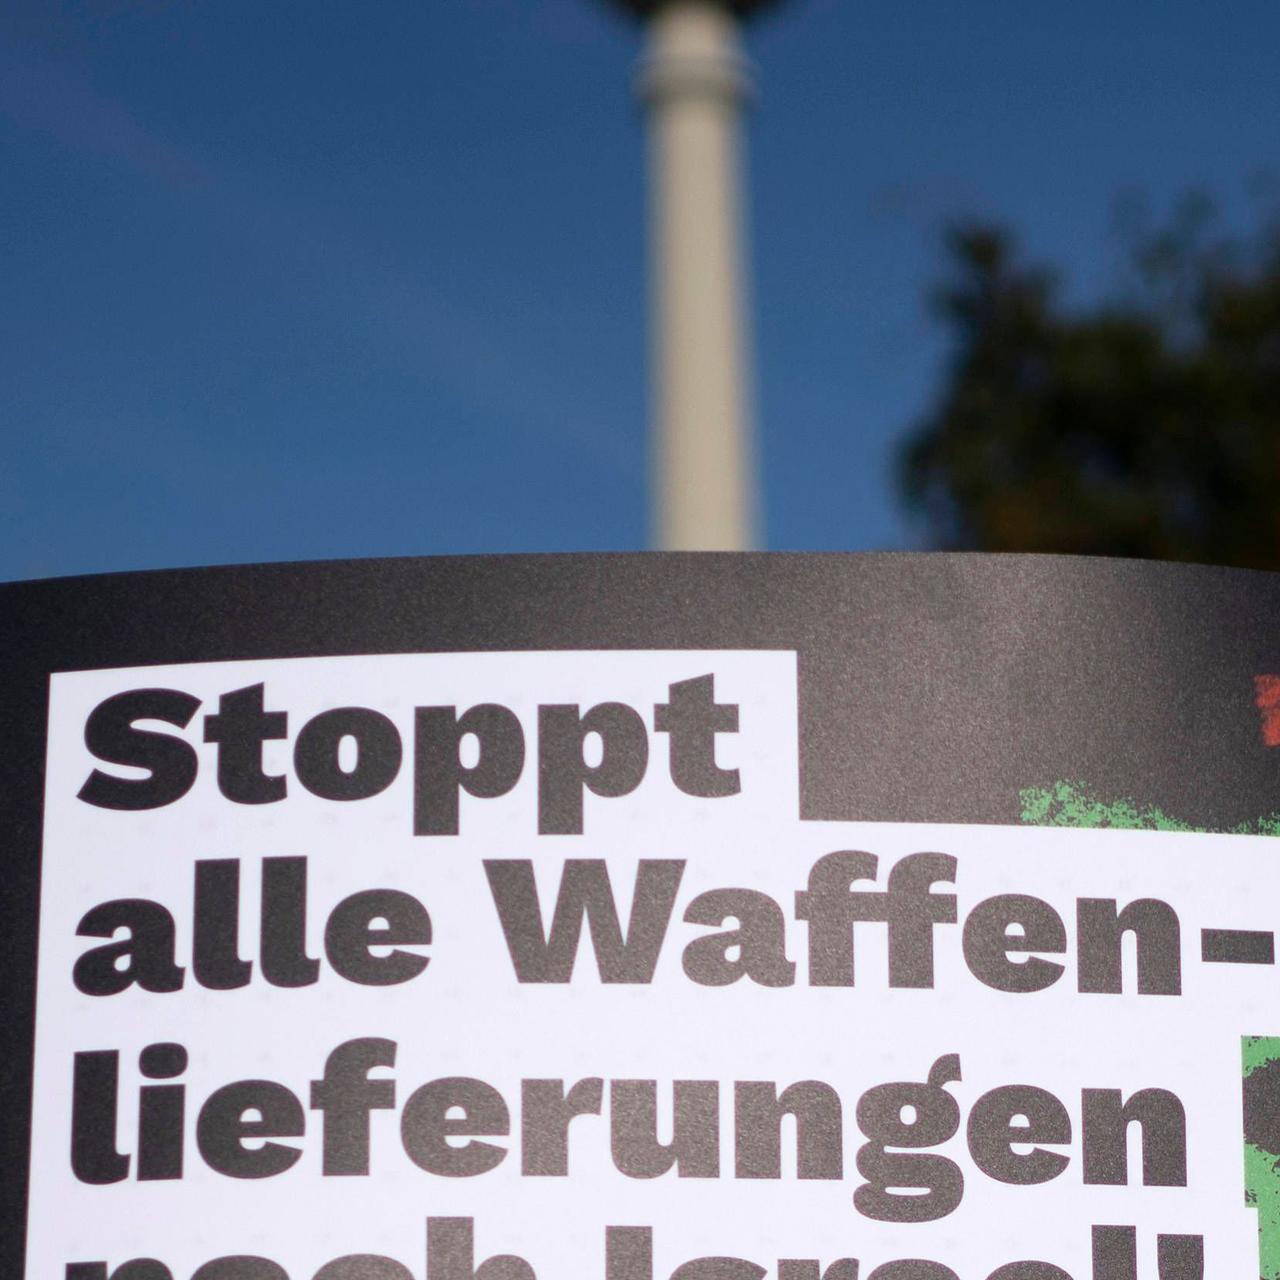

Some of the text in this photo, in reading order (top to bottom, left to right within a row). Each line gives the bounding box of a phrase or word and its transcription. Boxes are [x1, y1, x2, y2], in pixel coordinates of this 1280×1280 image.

[76, 673, 741, 836] Stoppt
[72, 849, 1276, 997] alle Waffen-
[69, 1036, 1188, 1223] lieferungen
